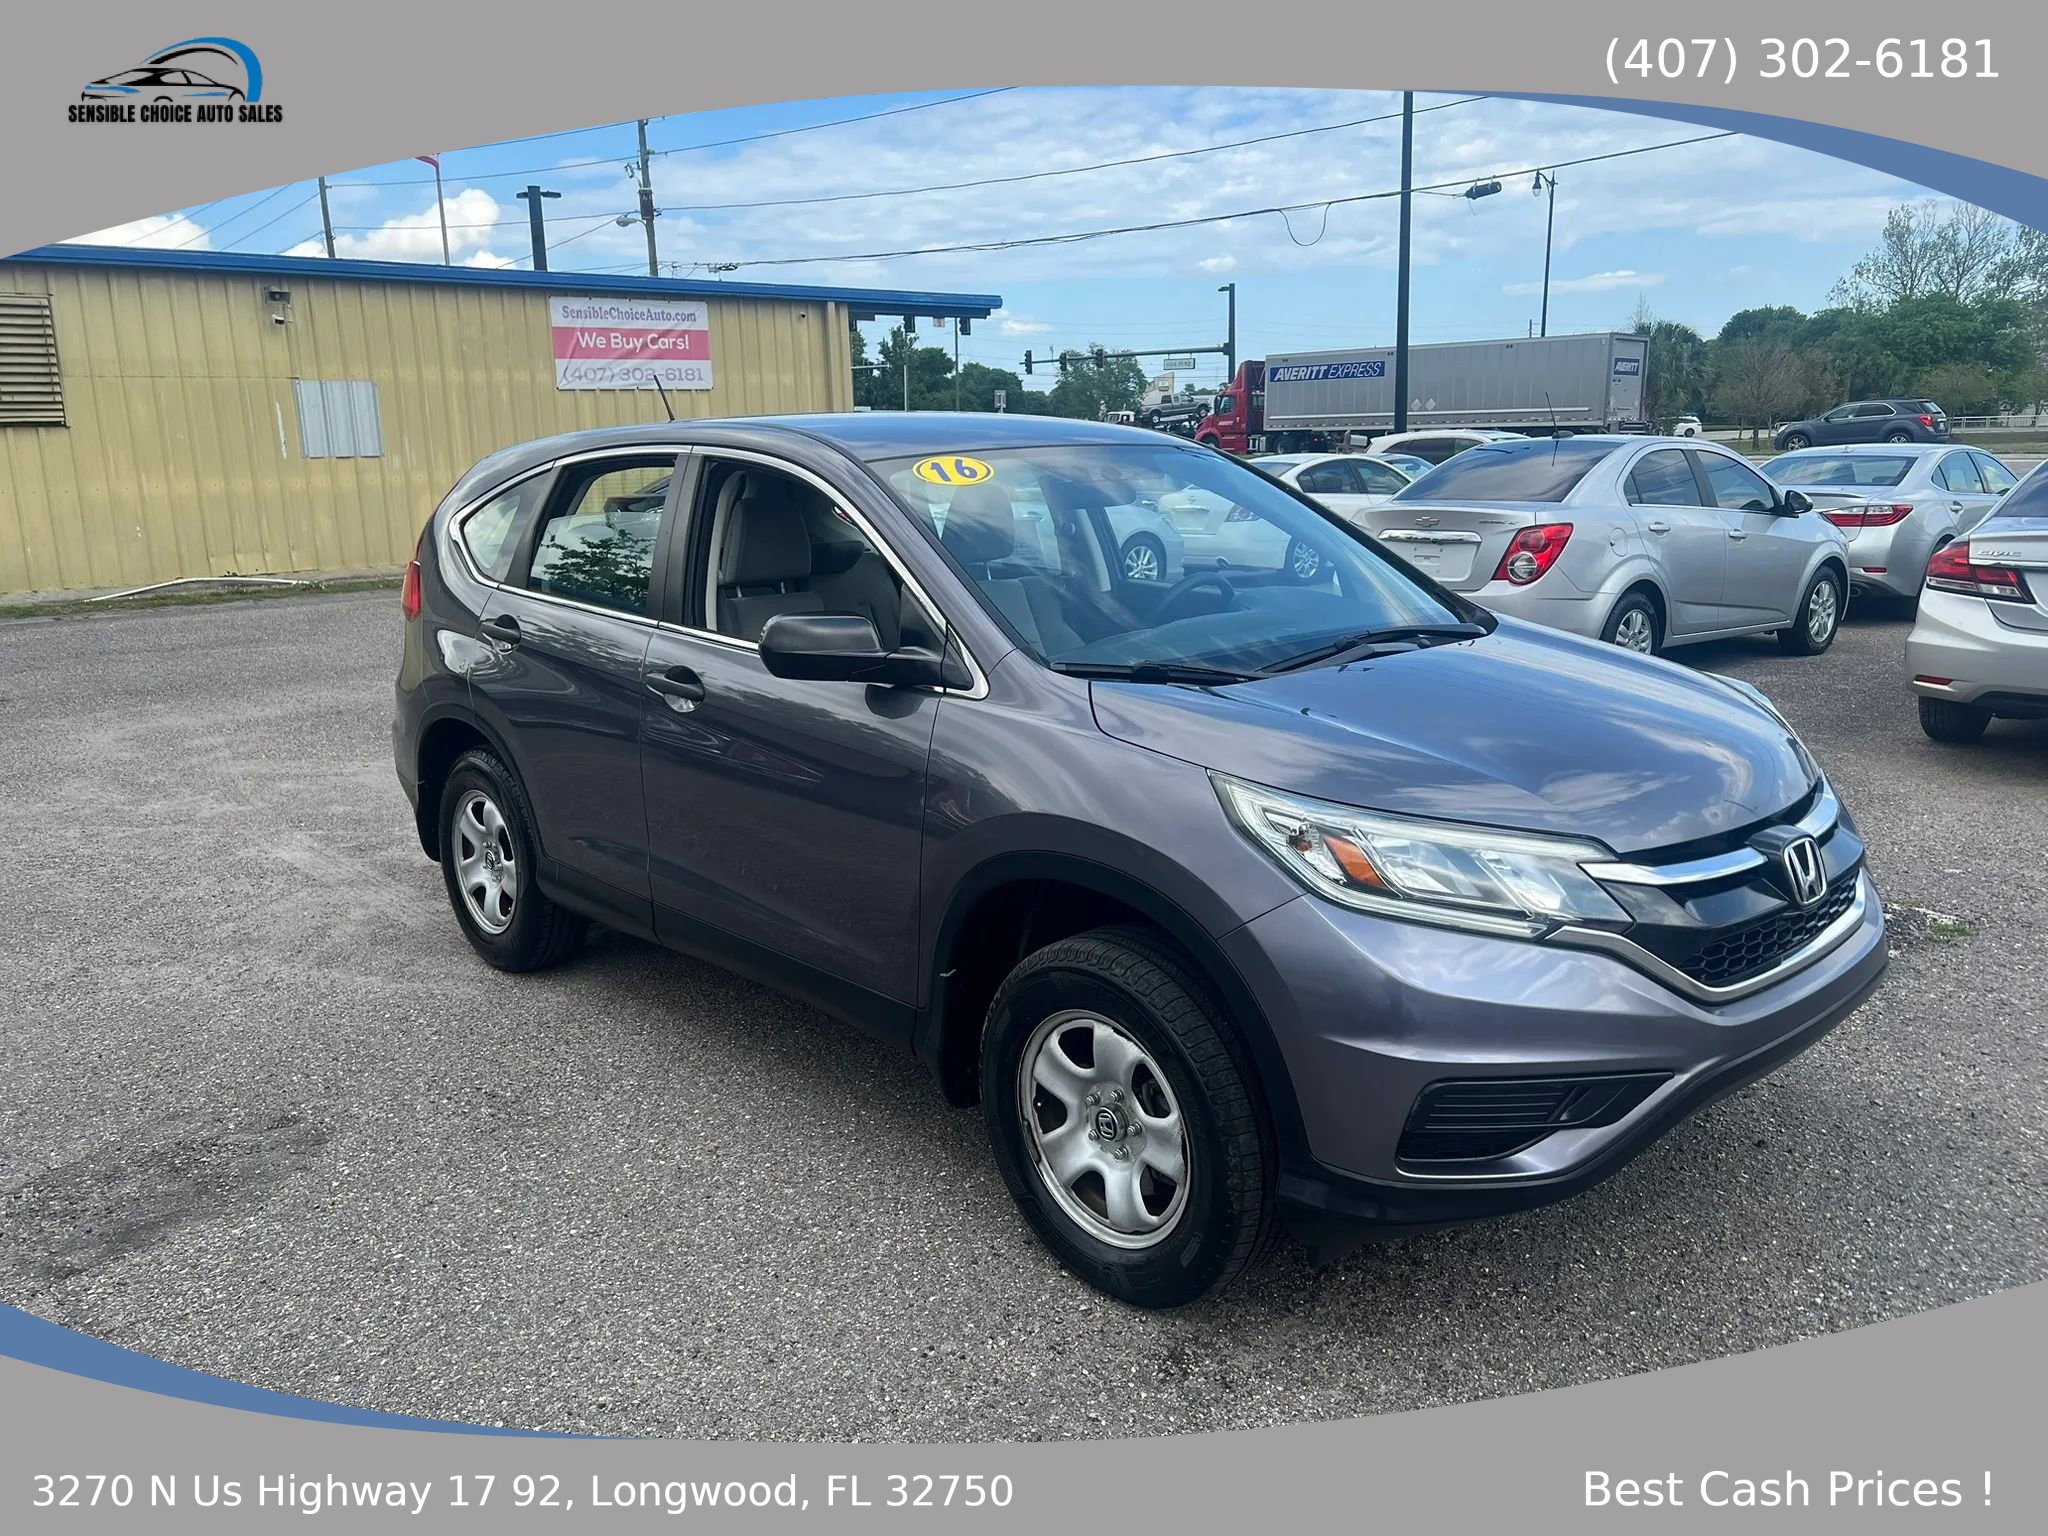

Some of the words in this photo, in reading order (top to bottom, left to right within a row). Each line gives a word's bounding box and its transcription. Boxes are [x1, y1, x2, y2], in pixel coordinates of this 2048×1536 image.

[561, 305, 697, 322] SensibleChoiceAuto.com
[577, 332, 606, 348] We
[610, 333, 643, 352] Buy
[647, 333, 690, 350] Cars!
[562, 366, 615, 383] (407)
[620, 367, 703, 382] 302-6181
[1274, 366, 1328, 381] AVERITT
[1328, 362, 1381, 378] EXPRESS
[930, 458, 978, 482] 16
